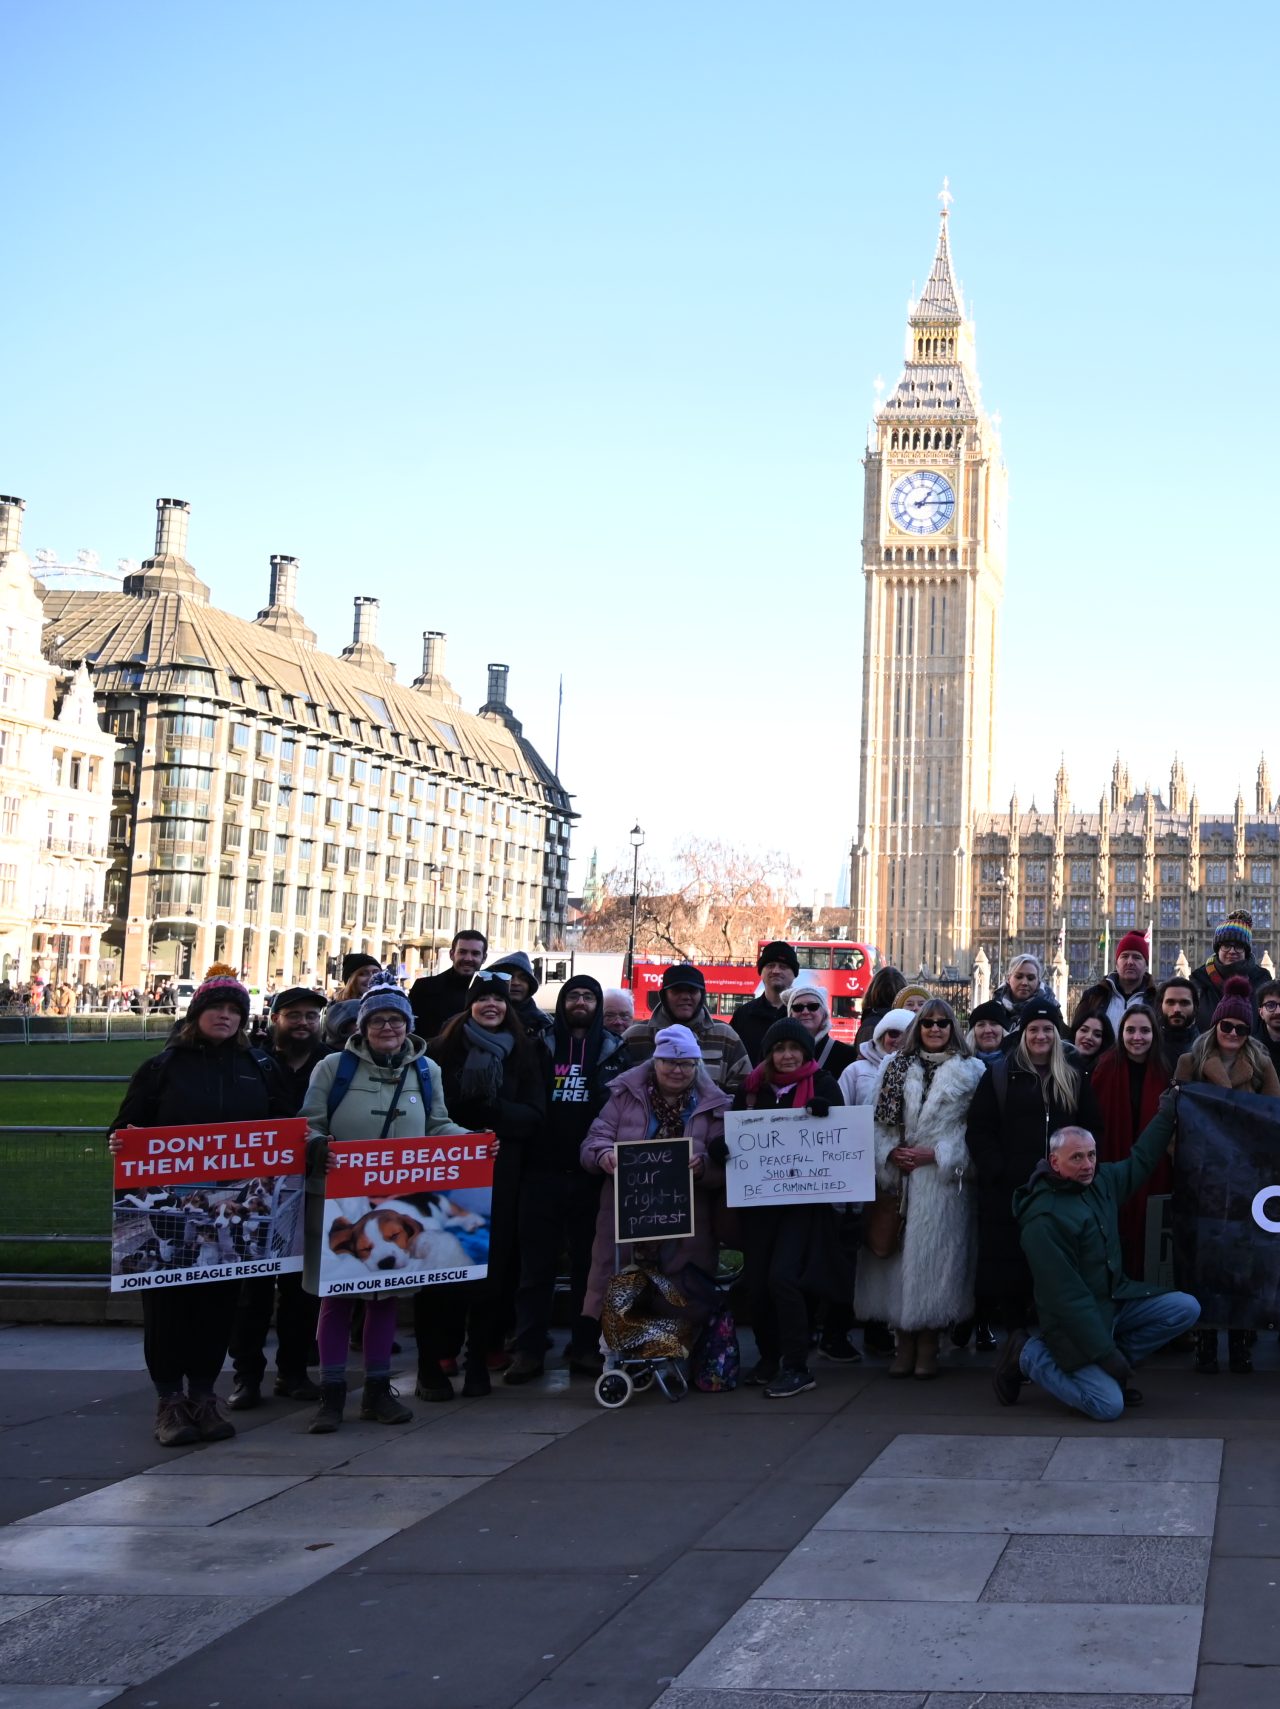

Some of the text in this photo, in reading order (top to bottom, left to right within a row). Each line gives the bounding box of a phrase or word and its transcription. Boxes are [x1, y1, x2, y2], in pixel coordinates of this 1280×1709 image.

[554, 1064, 581, 1076] WE
[554, 1076, 587, 1089] THE
[148, 1131, 278, 1155] DON'T LET
[738, 1128, 848, 1151] OUR RIGHT
[121, 1150, 295, 1177] THEM KILL US
[336, 1145, 488, 1169] FREE BEAGLE
[623, 1147, 672, 1166] Save
[730, 1150, 865, 1170] TO PEACEFUL PROTEST
[364, 1165, 460, 1186] PUPPIES
[627, 1170, 660, 1186] our
[809, 1168, 830, 1177] NOT
[624, 1188, 671, 1212] right
[744, 1180, 846, 1198] BE CRIMINALIZED
[629, 1209, 686, 1234] protest
[120, 1261, 281, 1289] JOIN OUR BEAGLE RESCUE
[327, 1270, 468, 1294] JOIN OUR BEAGLE RESCUE
